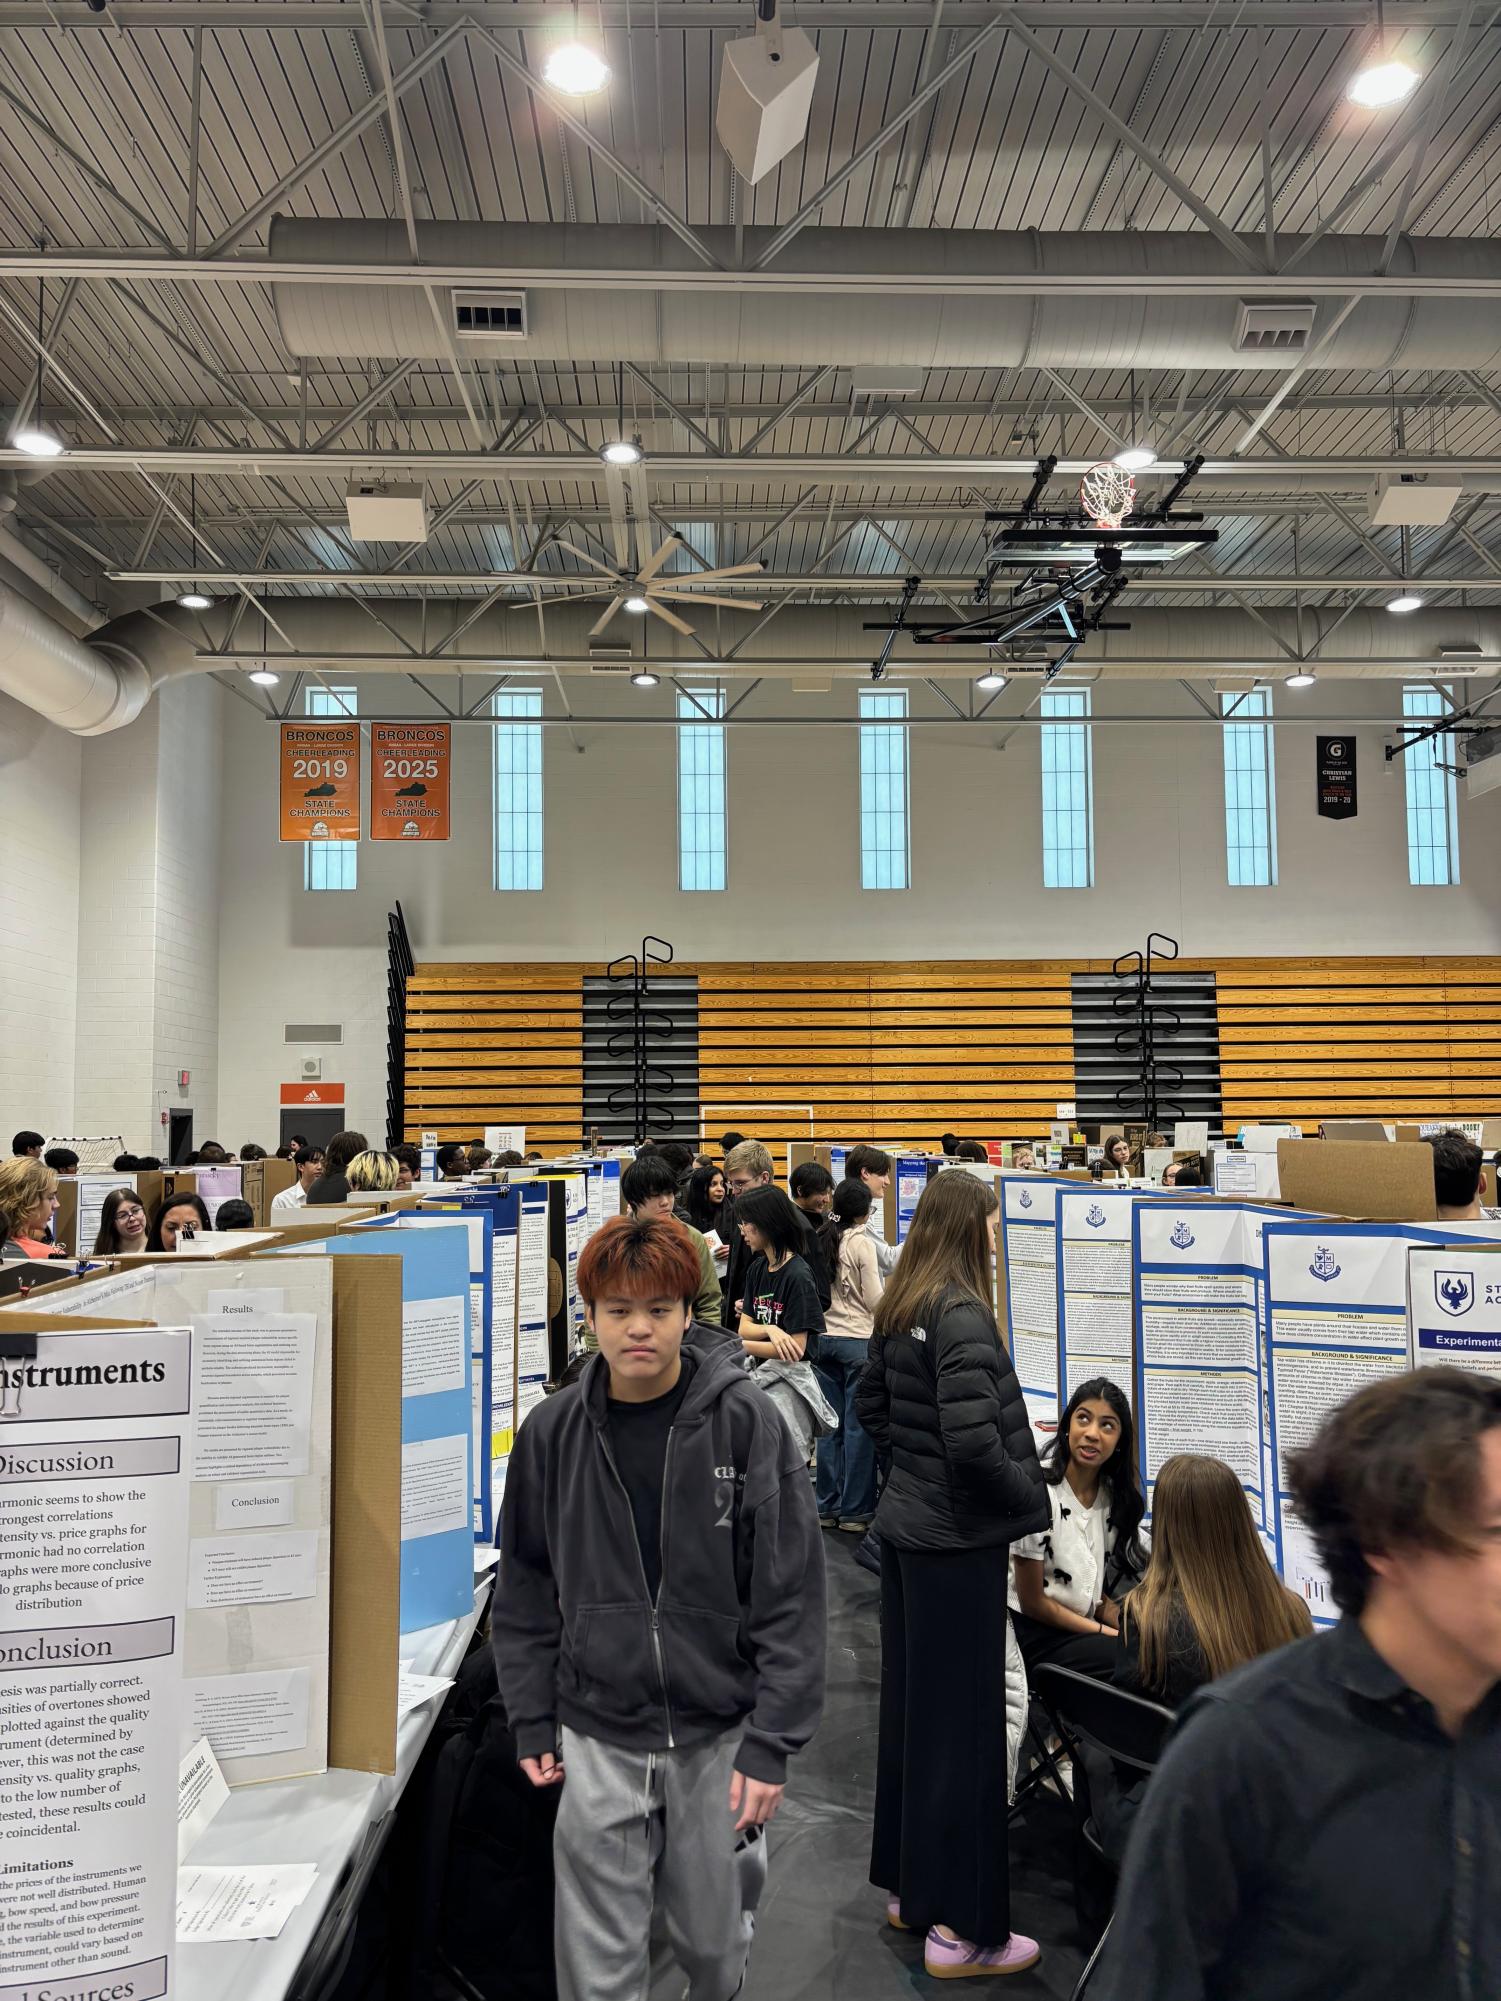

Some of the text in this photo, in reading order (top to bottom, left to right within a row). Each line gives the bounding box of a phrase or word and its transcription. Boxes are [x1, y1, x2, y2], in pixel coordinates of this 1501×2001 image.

[287, 731, 354, 740] BRONCOS
[378, 730, 445, 740] BRONCOS
[1330, 745, 1341, 756] G
[293, 760, 348, 778] 2019
[384, 760, 438, 778] 2025
[222, 1305, 253, 1313] Results
[46, 1496, 80, 1506] seems
[83, 1494, 93, 1504] to
[96, 1492, 125, 1502] show
[128, 1490, 146, 1500] the
[232, 1496, 279, 1507] Conclusion
[47, 1510, 113, 1522] correlations
[59, 1528, 86, 1541] price
[90, 1526, 127, 1539] graphs
[130, 1524, 147, 1534] for
[43, 1546, 64, 1557] had
[67, 1547, 81, 1556] no
[84, 1542, 145, 1554] correlation
[32, 1565, 58, 1574] were
[93, 1559, 151, 1571] conclusive
[13, 1583, 52, 1596] graphs
[55, 1580, 98, 1591] because
[102, 1577, 114, 1587] of
[116, 1576, 144, 1589] price
[16, 1597, 82, 1610] distribution
[1, 1676, 143, 1696] esis was partially correct.
[35, 1701, 46, 1712] of
[49, 1700, 104, 1711] overtones
[107, 1690, 150, 1705] showed
[1, 1709, 150, 1734] plotted against the quality
[45, 1730, 116, 1748] (determined
[120, 1728, 133, 1740] by
[27, 1755, 48, 1766] this
[52, 1755, 73, 1764] was
[77, 1751, 96, 1762] not
[99, 1748, 117, 1759] the
[120, 1745, 144, 1756] case
[37, 1774, 52, 1782] vs.
[56, 1768, 95, 1783] quality
[98, 1763, 140, 1778] graphs,
[1, 1781, 122, 1803] to the low number of
[39, 1807, 70, 1818] these
[73, 1801, 112, 1814] results
[115, 1794, 146, 1809] could
[6, 1821, 80, 1839] coincidental.
[0, 1864, 141, 1890] the prices of the instruments we
[20, 1894, 35, 1902] not
[38, 1890, 55, 1899] well
[58, 1884, 110, 1898] distributed.
[113, 1876, 146, 1890] Human
[8, 1891, 140, 1917] bow speed, and bow pressure
[7, 1904, 141, 1930] the results of this experiment.
[8, 1916, 144, 1945] the variable used to determine
[54, 1941, 79, 1953] could
[81, 1939, 102, 1949] vary
[104, 1934, 129, 1945] based
[132, 1931, 143, 1939] on
[51, 1958, 75, 1967] other
[78, 1953, 102, 1962] than
[100, 1947, 131, 1960] sound.
